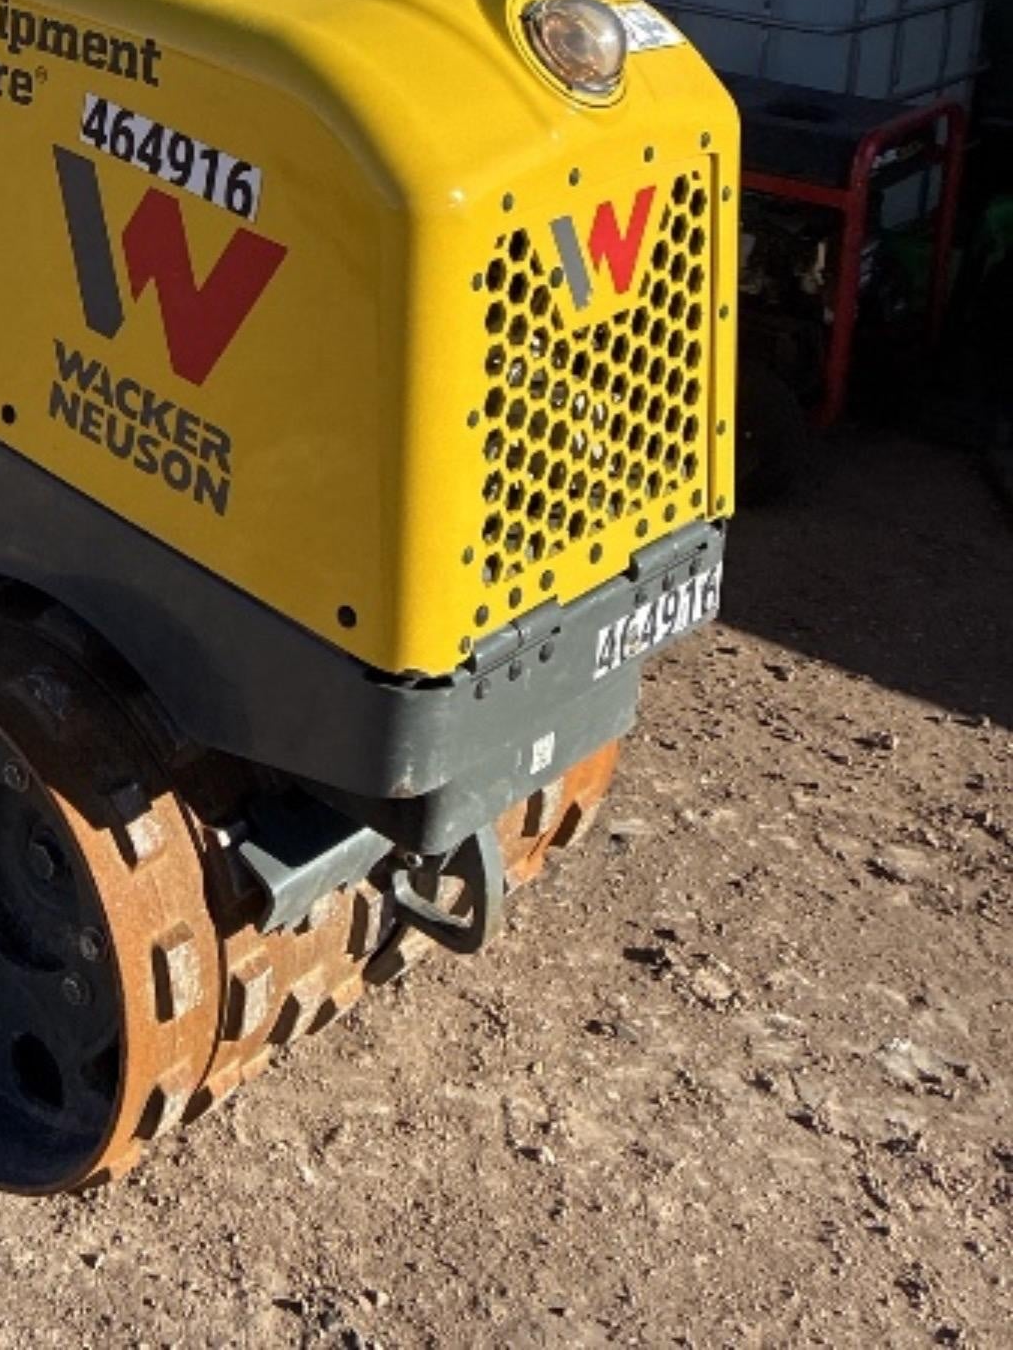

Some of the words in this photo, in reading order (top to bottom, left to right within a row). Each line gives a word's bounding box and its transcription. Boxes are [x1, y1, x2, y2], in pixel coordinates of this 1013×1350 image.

[82, 96, 255, 219] 464916
[49, 380, 231, 516] NEUSON
[53, 339, 231, 473] WACKER
